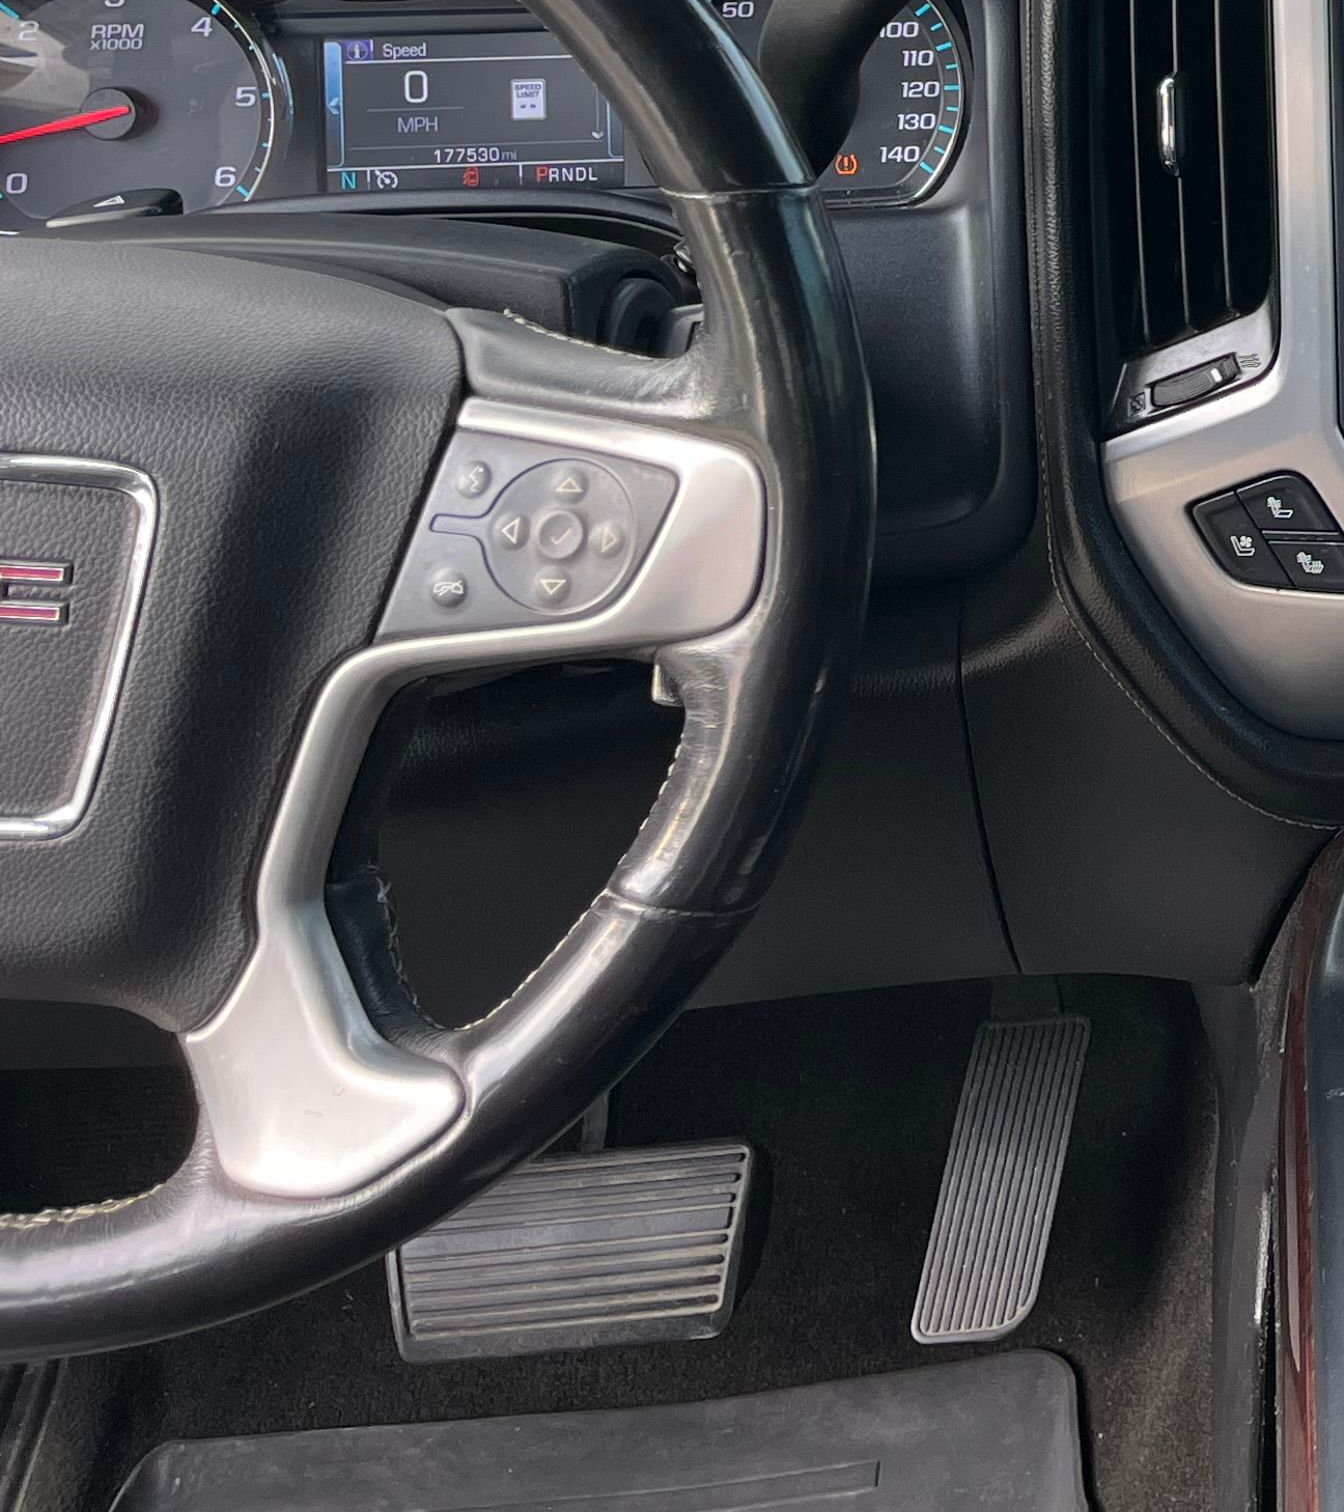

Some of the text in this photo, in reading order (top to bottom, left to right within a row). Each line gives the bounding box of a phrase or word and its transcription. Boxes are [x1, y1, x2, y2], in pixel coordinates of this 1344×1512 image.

[722, 2, 754, 18] 50
[17, 21, 39, 41] 2
[90, 23, 145, 39] RPM
[191, 16, 213, 37] 4
[382, 43, 427, 59] Speed
[902, 50, 934, 66] 110
[404, 70, 428, 103] 0
[514, 83, 541, 91] SPEED
[516, 90, 540, 99] LIMIT
[901, 82, 940, 98] 120
[235, 86, 257, 107] 5
[398, 116, 438, 133] MPH
[897, 113, 936, 130] 130
[433, 147, 517, 163] 177530 mi
[879, 146, 920, 162] 140
[5, 173, 28, 194] 0
[214, 166, 237, 188] 6
[342, 171, 357, 189] N
